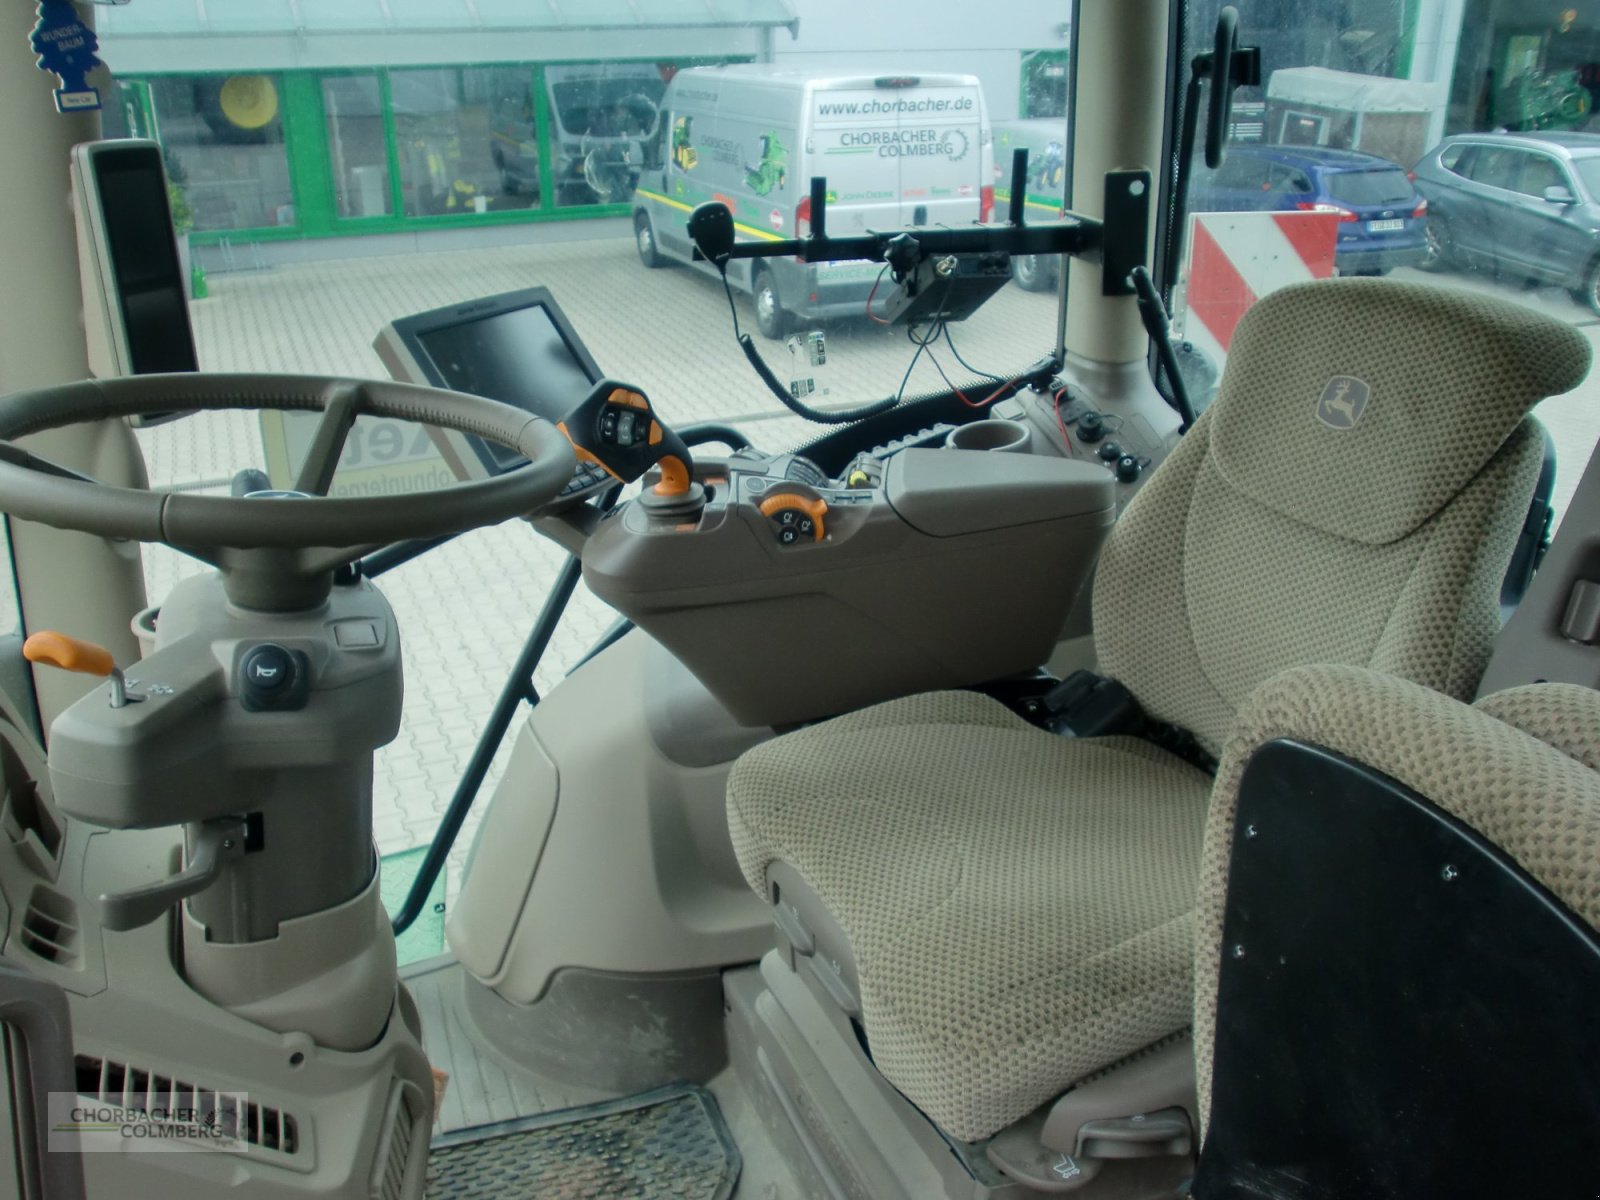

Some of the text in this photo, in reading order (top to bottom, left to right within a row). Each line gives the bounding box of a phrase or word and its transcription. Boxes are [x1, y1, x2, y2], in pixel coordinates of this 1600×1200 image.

[40, 24, 81, 42] WUNDER
[57, 36, 86, 51] BAUM
[818, 96, 973, 116] www.chorbacher.de
[840, 129, 937, 147] CHORBACHER
[878, 142, 954, 158] COLMBERG
